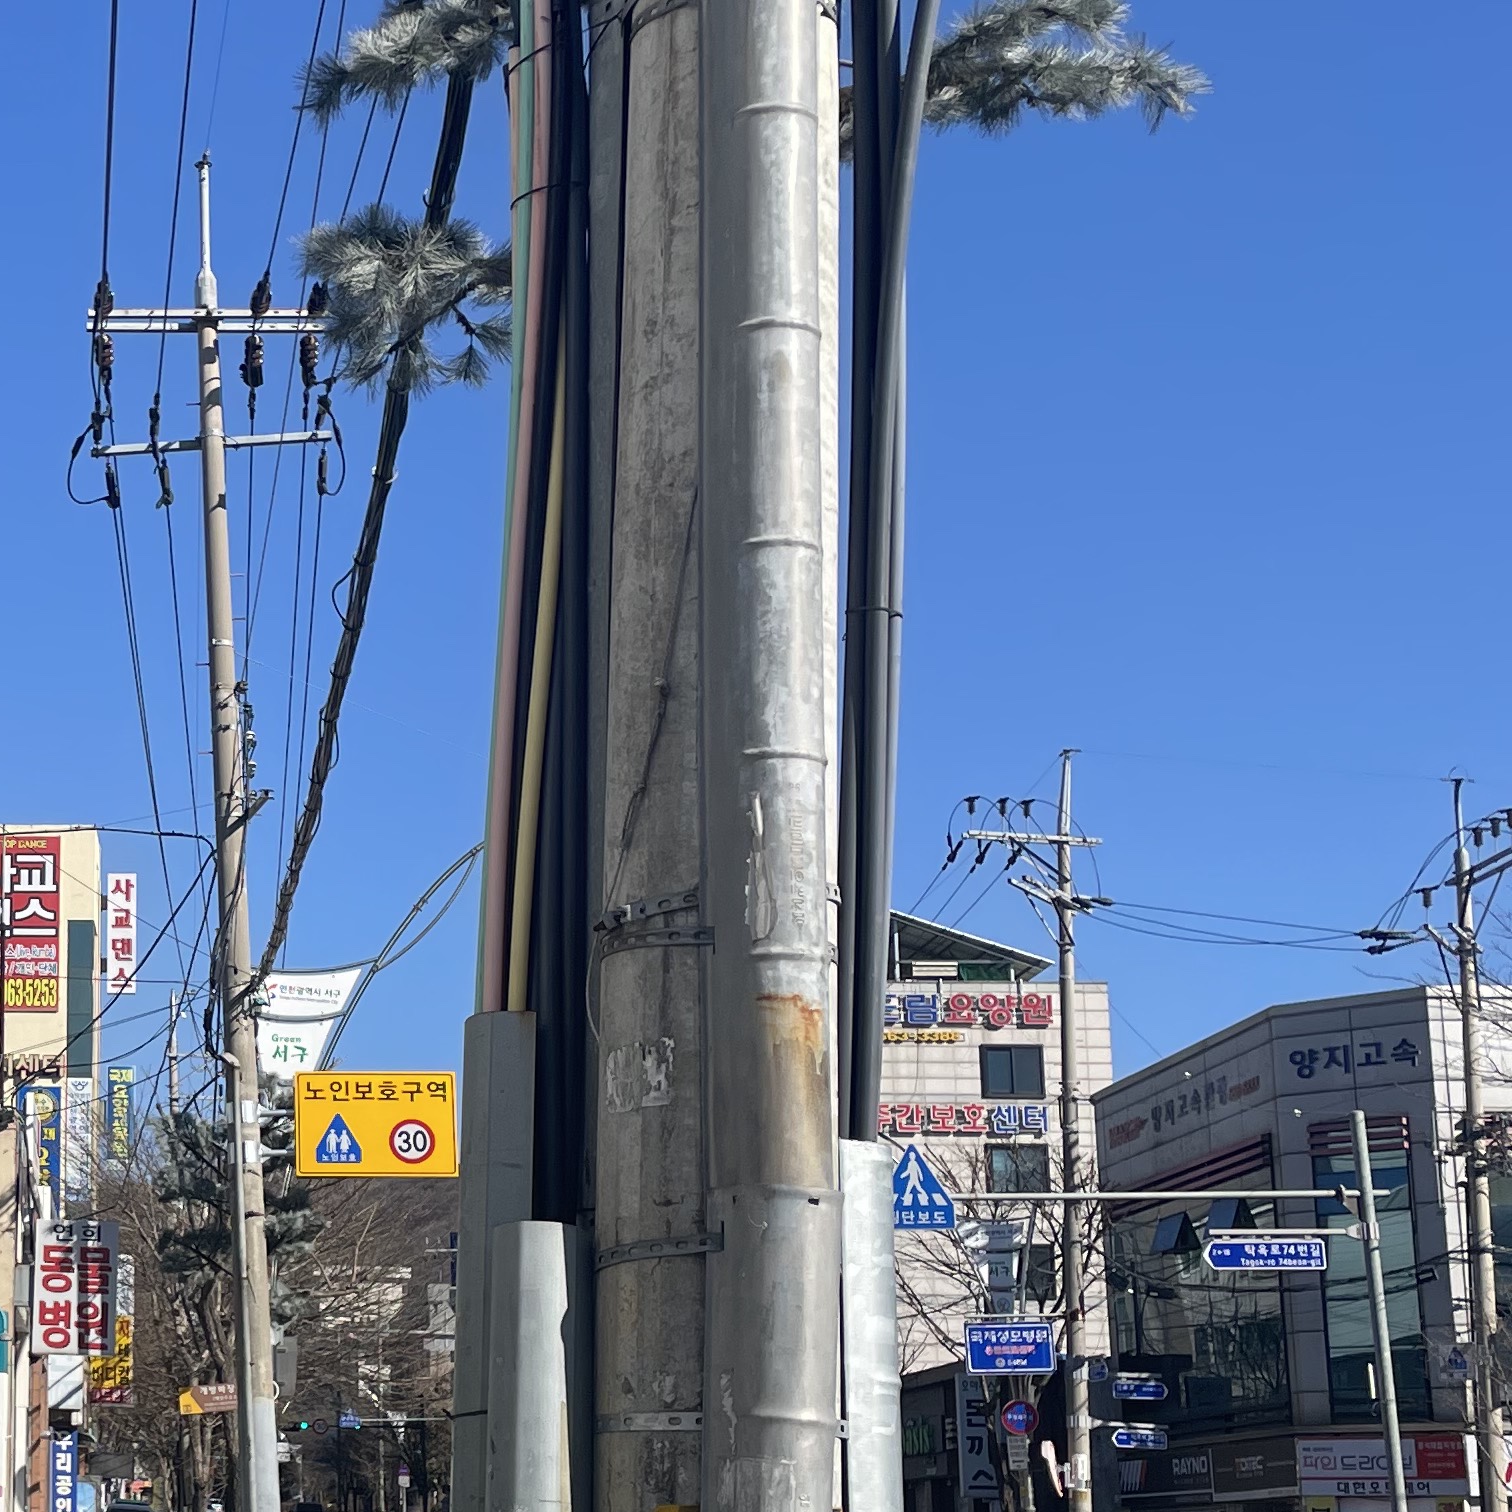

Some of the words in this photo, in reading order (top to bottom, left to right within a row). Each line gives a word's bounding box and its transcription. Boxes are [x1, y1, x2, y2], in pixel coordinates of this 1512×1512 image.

[110, 878, 135, 989] 사교댄스
[279, 985, 321, 997] 인천광역시
[324, 989, 341, 999] 서구
[271, 1033, 302, 1043] Green
[272, 1045, 309, 1064] 서구
[1289, 1038, 1422, 1079] 양지고속
[303, 1080, 448, 1103] 노인보호구역
[397, 1130, 428, 1153] 30
[53, 1223, 101, 1243] 연희
[1172, 1456, 1209, 1476] RAYNO
